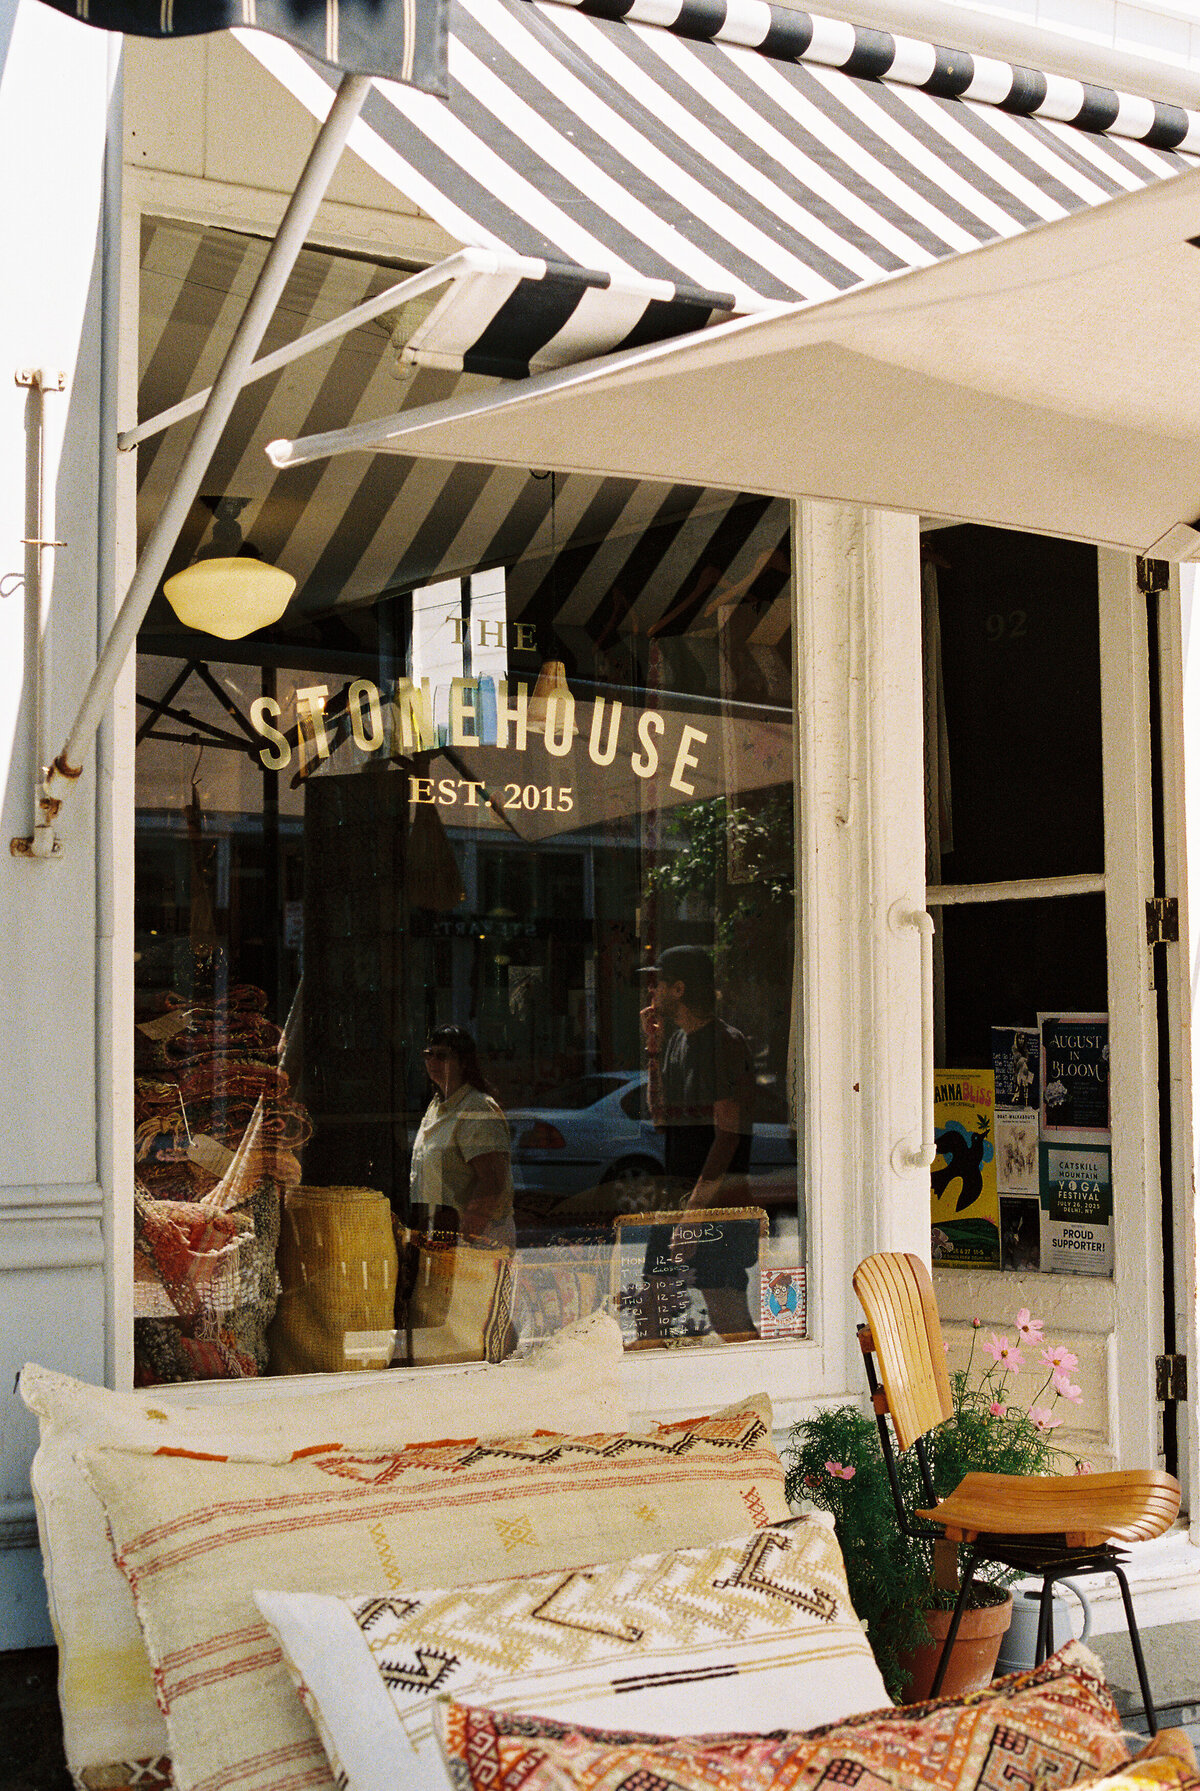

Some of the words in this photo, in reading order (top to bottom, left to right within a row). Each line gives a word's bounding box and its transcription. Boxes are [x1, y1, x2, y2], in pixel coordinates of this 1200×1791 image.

[986, 610, 1027, 641] 92
[446, 615, 537, 652] THE
[249, 676, 708, 796] STONEHOUSE
[407, 776, 492, 808] EST.
[503, 782, 574, 813] 2015
[1049, 1034, 1102, 1049] AUGUST
[1069, 1051, 1080, 1061] IN
[1051, 1061, 1104, 1083] BLOOM
[1059, 1162, 1098, 1171] CATSKILL
[1059, 1171, 1098, 1179] MOUNTAIN
[1058, 1180, 1100, 1193] YOGA
[1058, 1191, 1099, 1201] FESTIVAL
[671, 1223, 724, 1242] HOURS
[1063, 1229, 1094, 1240] PROUD
[1052, 1238, 1105, 1252] SUPPORTER!
[621, 1256, 646, 1266] MON
[621, 1295, 643, 1305] THU
